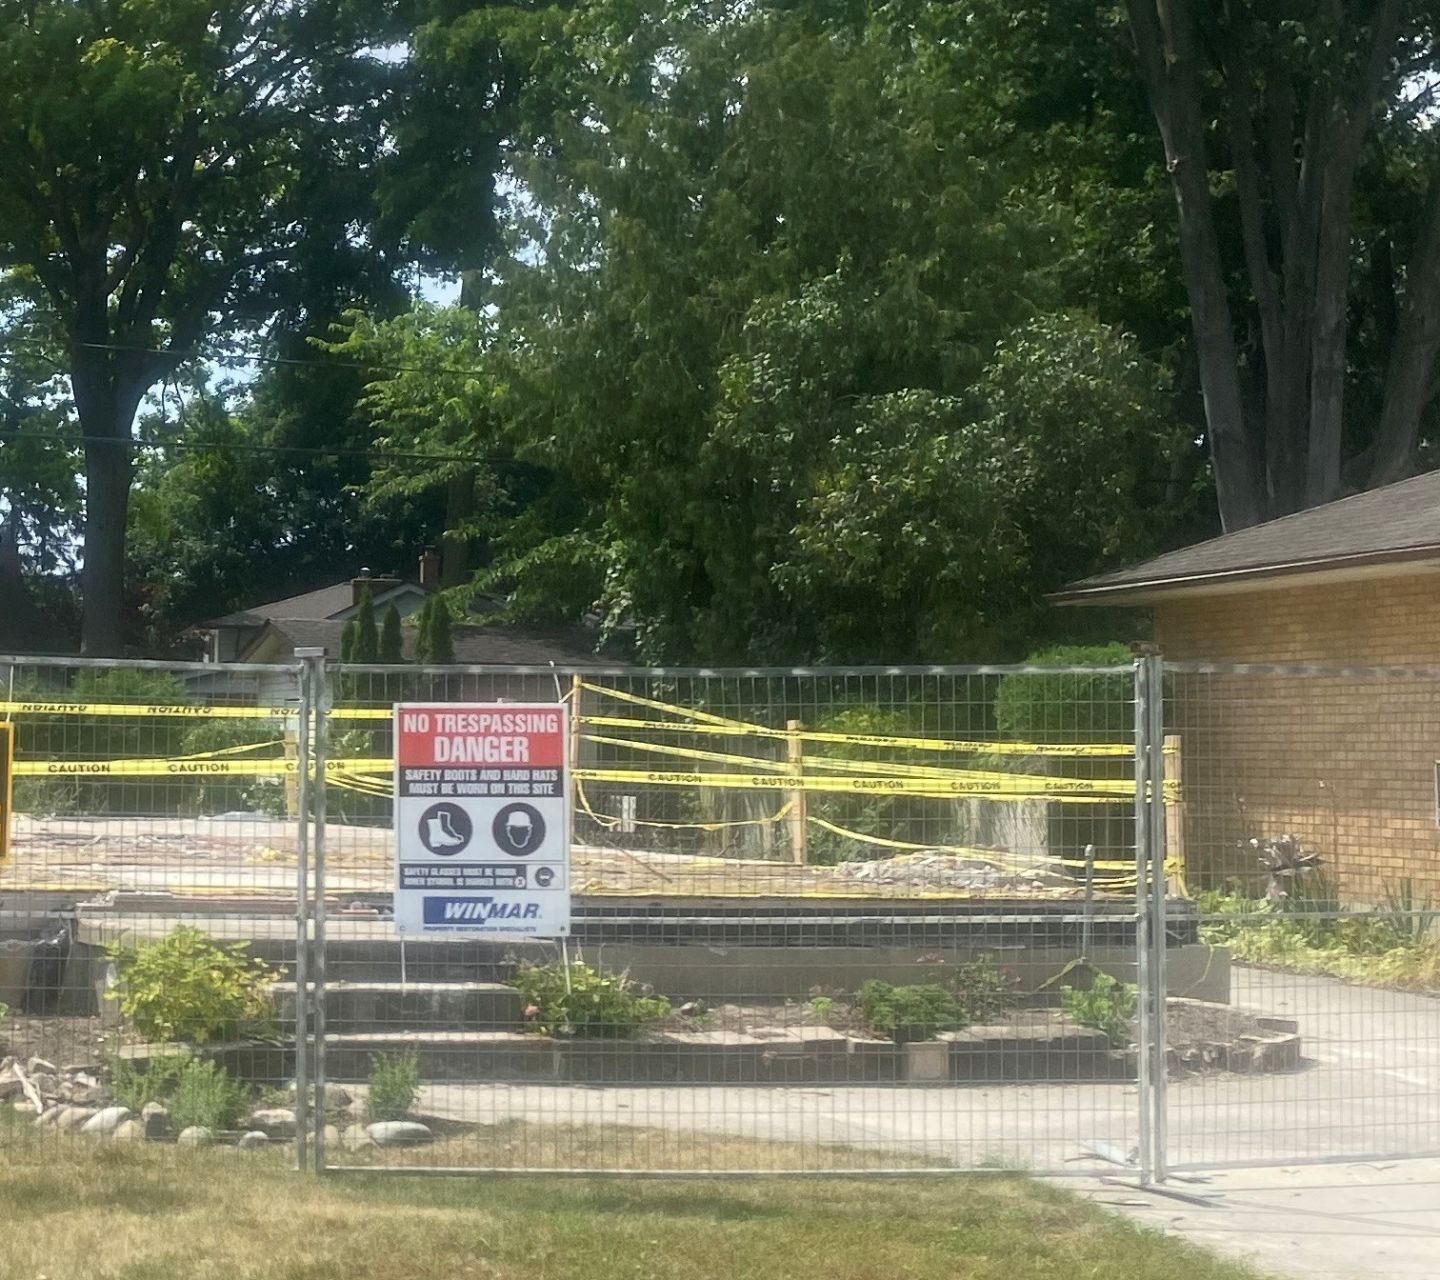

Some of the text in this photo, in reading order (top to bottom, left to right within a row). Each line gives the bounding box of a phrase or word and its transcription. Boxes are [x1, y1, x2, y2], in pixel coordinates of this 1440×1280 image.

[21, 703, 88, 713] CAUTION
[146, 705, 213, 715] CAUTION
[403, 713, 558, 734] NO TRESPASSING
[433, 735, 530, 763] DANGER
[47, 763, 111, 774] CAUTION
[168, 763, 230, 774] CAUTION
[404, 769, 558, 781] SAFETY BOOTS AND HARD HATS
[648, 773, 703, 783] CAUTION
[751, 775, 805, 787] CAUTION
[408, 782, 554, 795] MUST BE WORN ON THIS SITE
[852, 778, 904, 790] CAUTION
[950, 780, 1001, 791] CAUTION
[444, 902, 540, 919] WINMAR
